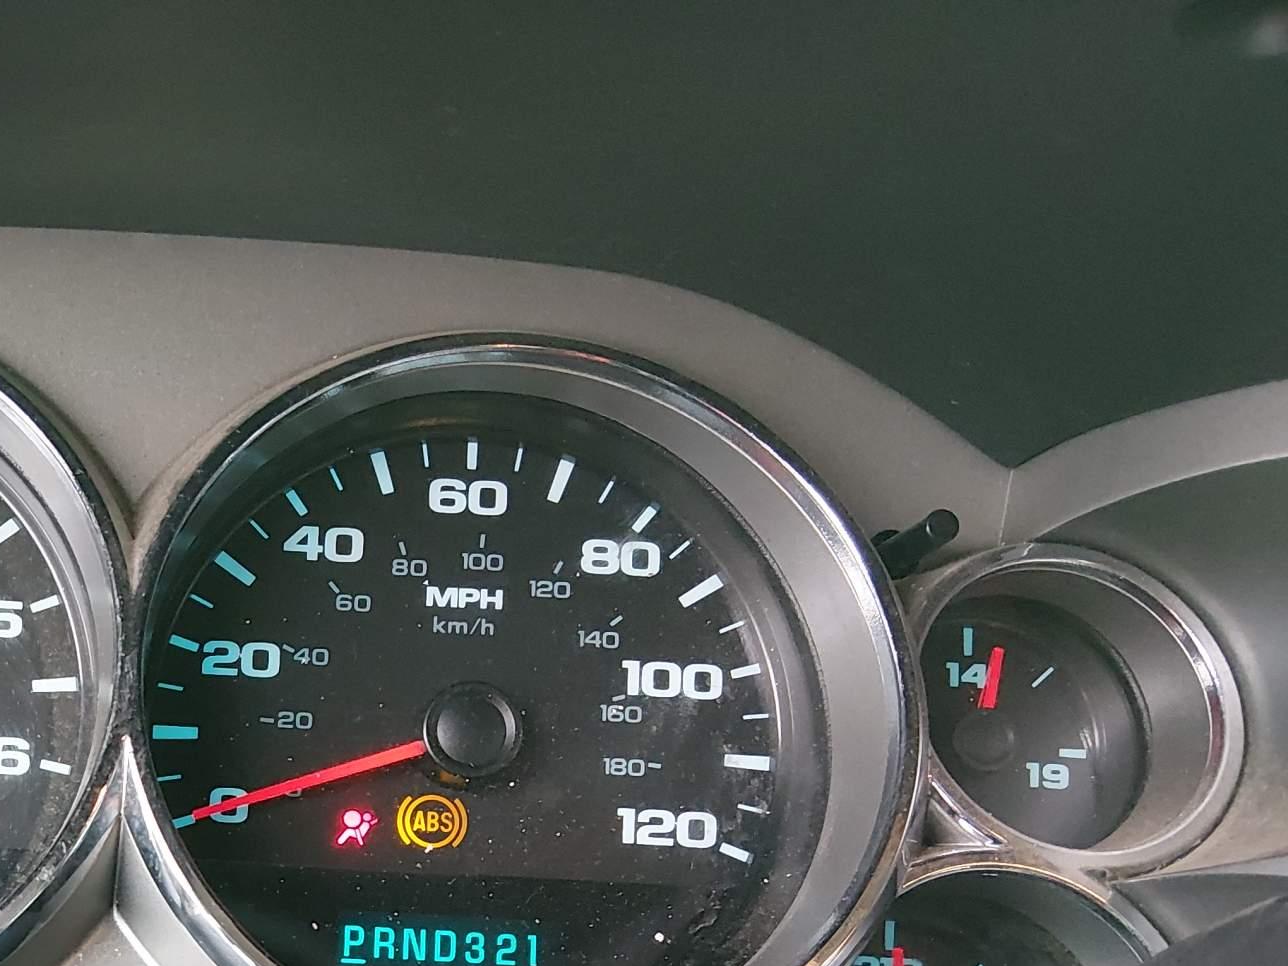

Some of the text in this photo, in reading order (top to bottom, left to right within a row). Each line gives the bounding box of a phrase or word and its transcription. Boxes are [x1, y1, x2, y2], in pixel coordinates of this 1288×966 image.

[428, 479, 508, 516] 60
[283, 525, 365, 563] 40
[391, 558, 428, 577] 80
[461, 552, 504, 571] 100
[580, 539, 661, 577] 80
[425, 586, 504, 610] MPH
[529, 580, 571, 599] 120
[335, 594, 372, 613] 60
[432, 615, 495, 636] km/h
[578, 630, 620, 649] 140
[201, 641, 281, 678] 20
[293, 647, 330, 666] 40
[622, 660, 723, 700] 100
[945, 661, 987, 689] 14
[277, 711, 313, 729] 20
[600, 704, 642, 723] 160
[603, 757, 645, 777] 180
[1025, 762, 1070, 790] 19
[209, 787, 249, 824] 0
[413, 810, 453, 833] ABS
[617, 807, 717, 849] 120
